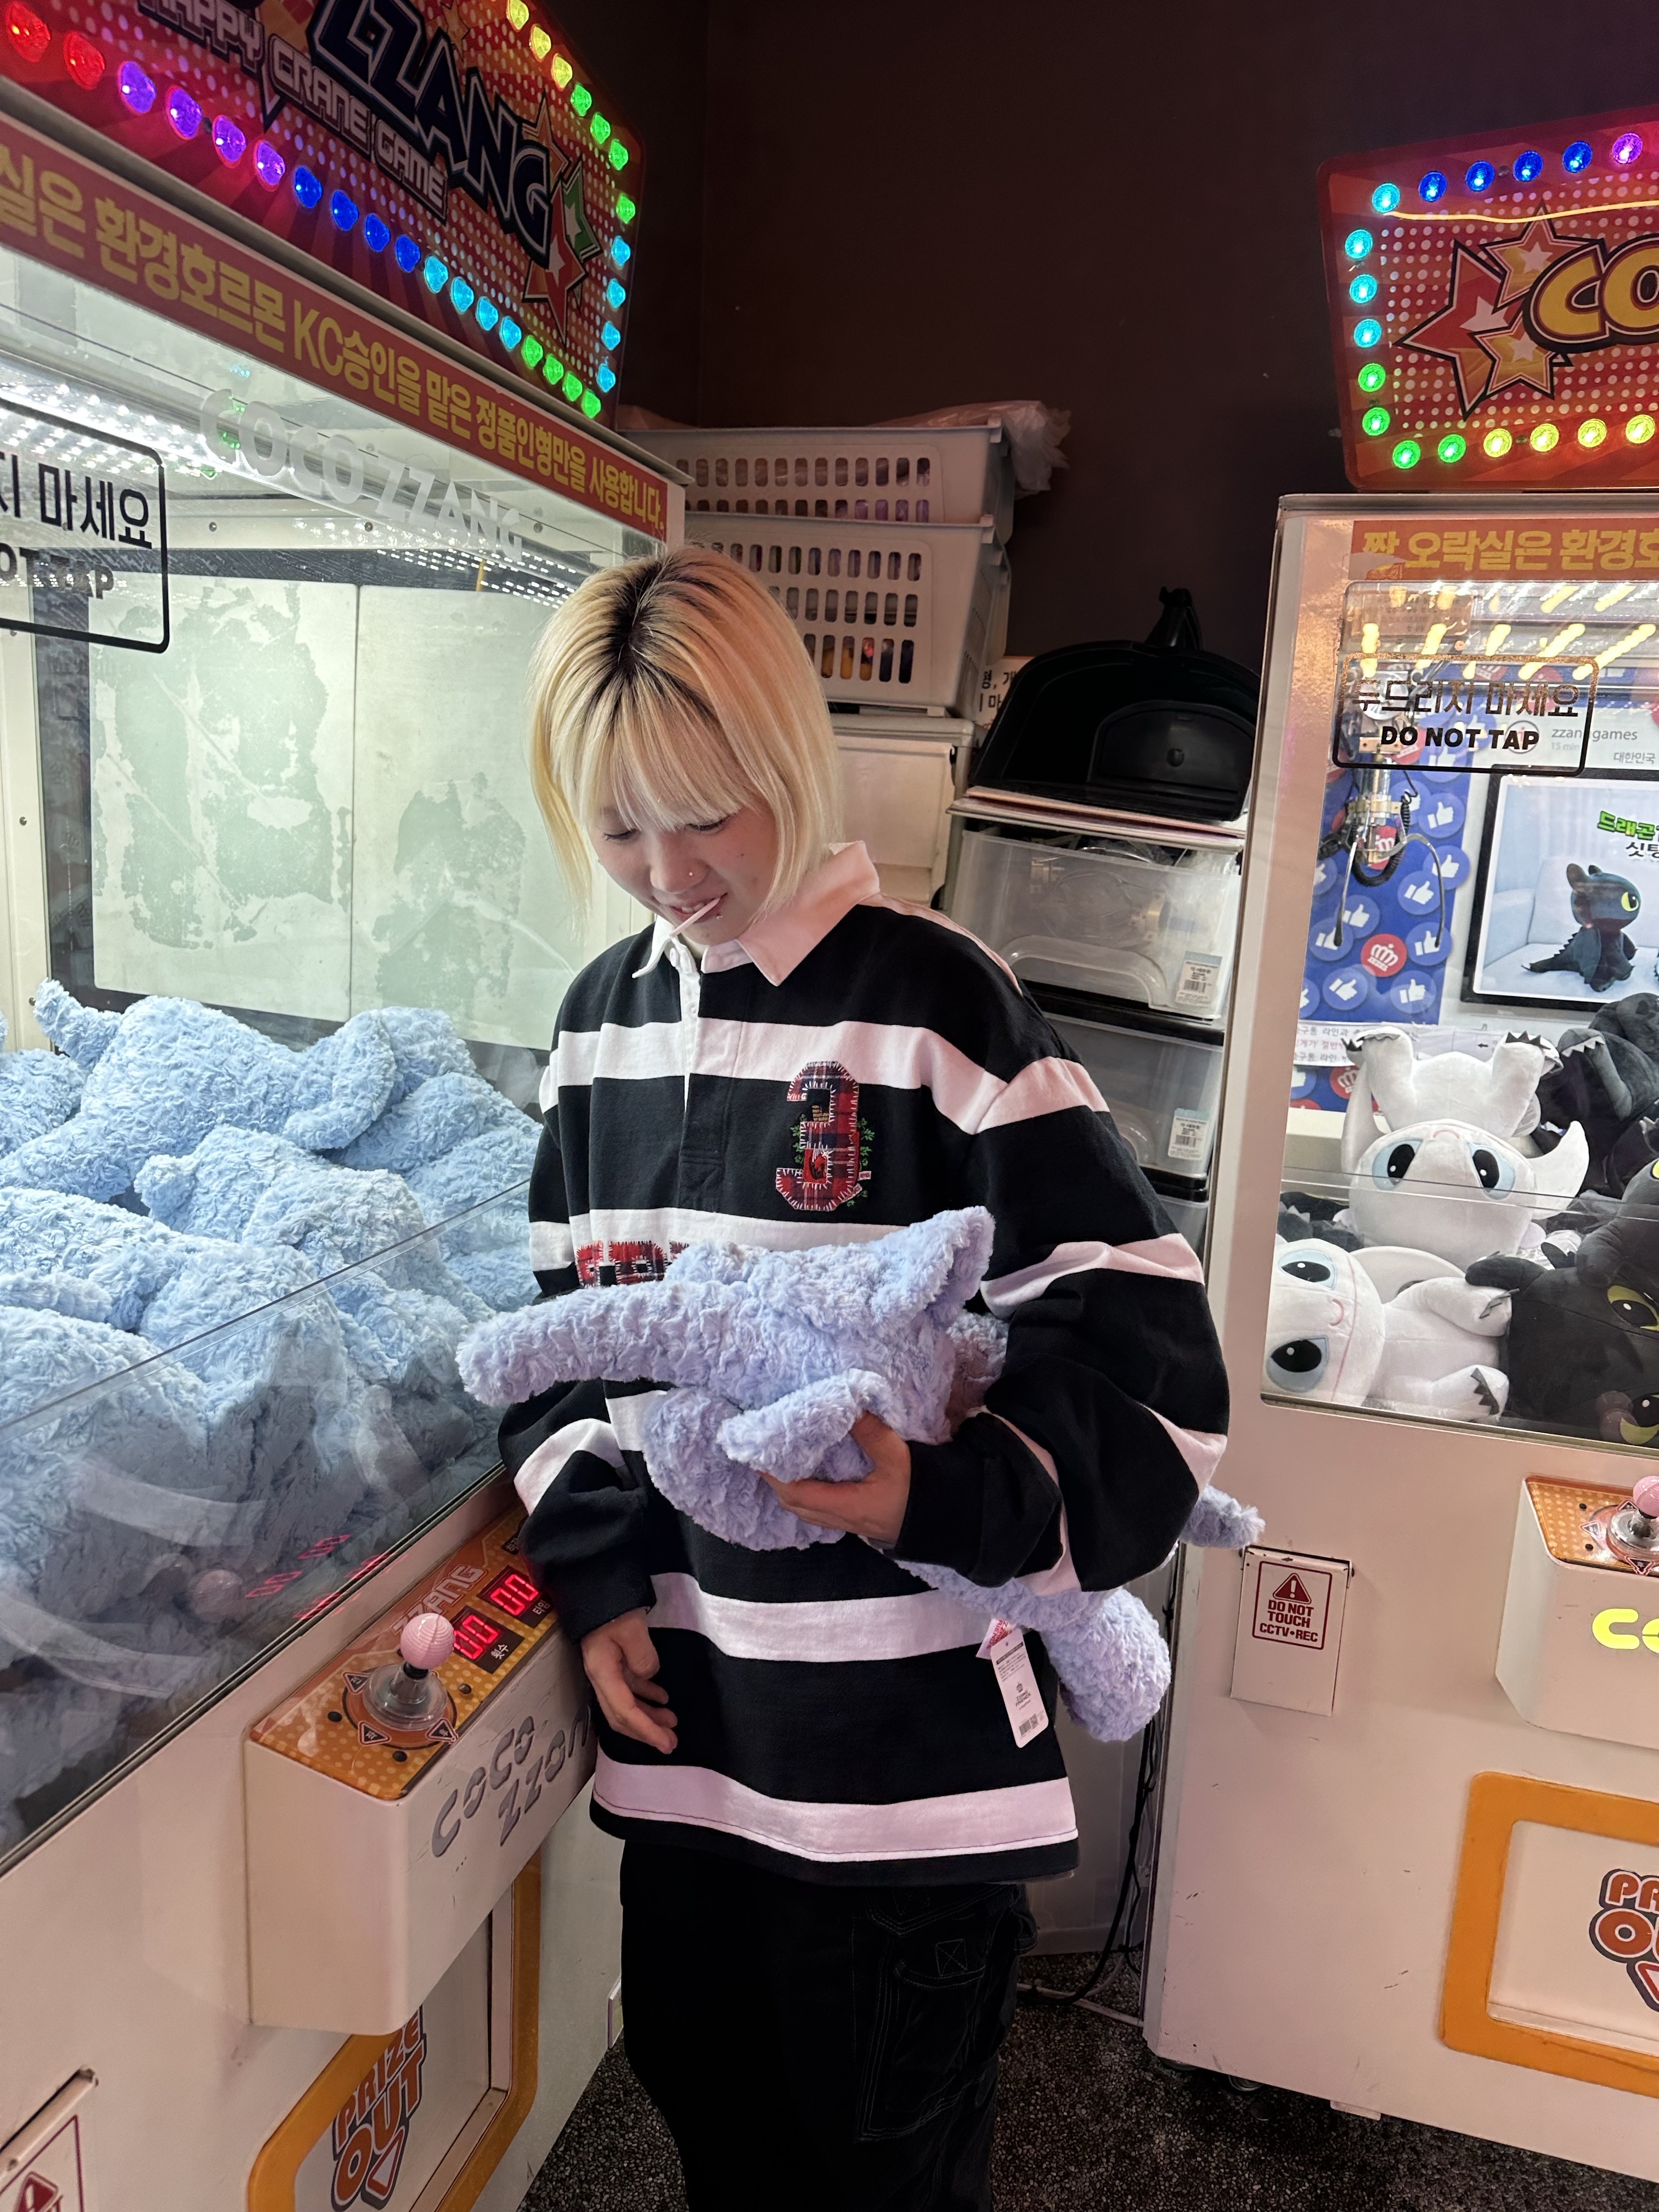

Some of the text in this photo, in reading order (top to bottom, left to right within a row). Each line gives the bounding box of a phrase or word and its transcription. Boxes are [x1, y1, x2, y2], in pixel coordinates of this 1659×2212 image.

[271, 35, 371, 147] CRANE
[376, 120, 448, 213] GAME
[0, 144, 86, 258] 실은
[94, 197, 286, 354] 환경호르몬
[294, 299, 422, 416] KC승인을
[426, 369, 472, 440] 맡은
[476, 395, 586, 494] 정품인형만을
[200, 388, 522, 563] COCO ZZANG
[38, 462, 153, 549] 마세요
[1405, 529, 1552, 571] 오락실은
[1352, 679, 1580, 718] 두드리지 마세요
[1380, 725, 1539, 751] DO NOT TAP
[1551, 729, 1638, 742] zzan games
[1613, 751, 1656, 764] 대한민국
[1597, 810, 1659, 841] 드래곤
[489, 1574, 539, 1616] 00
[1268, 1599, 1314, 1617] DO NOT
[1267, 1610, 1311, 1628] TOUCH
[335, 2039, 425, 2207] OUT
